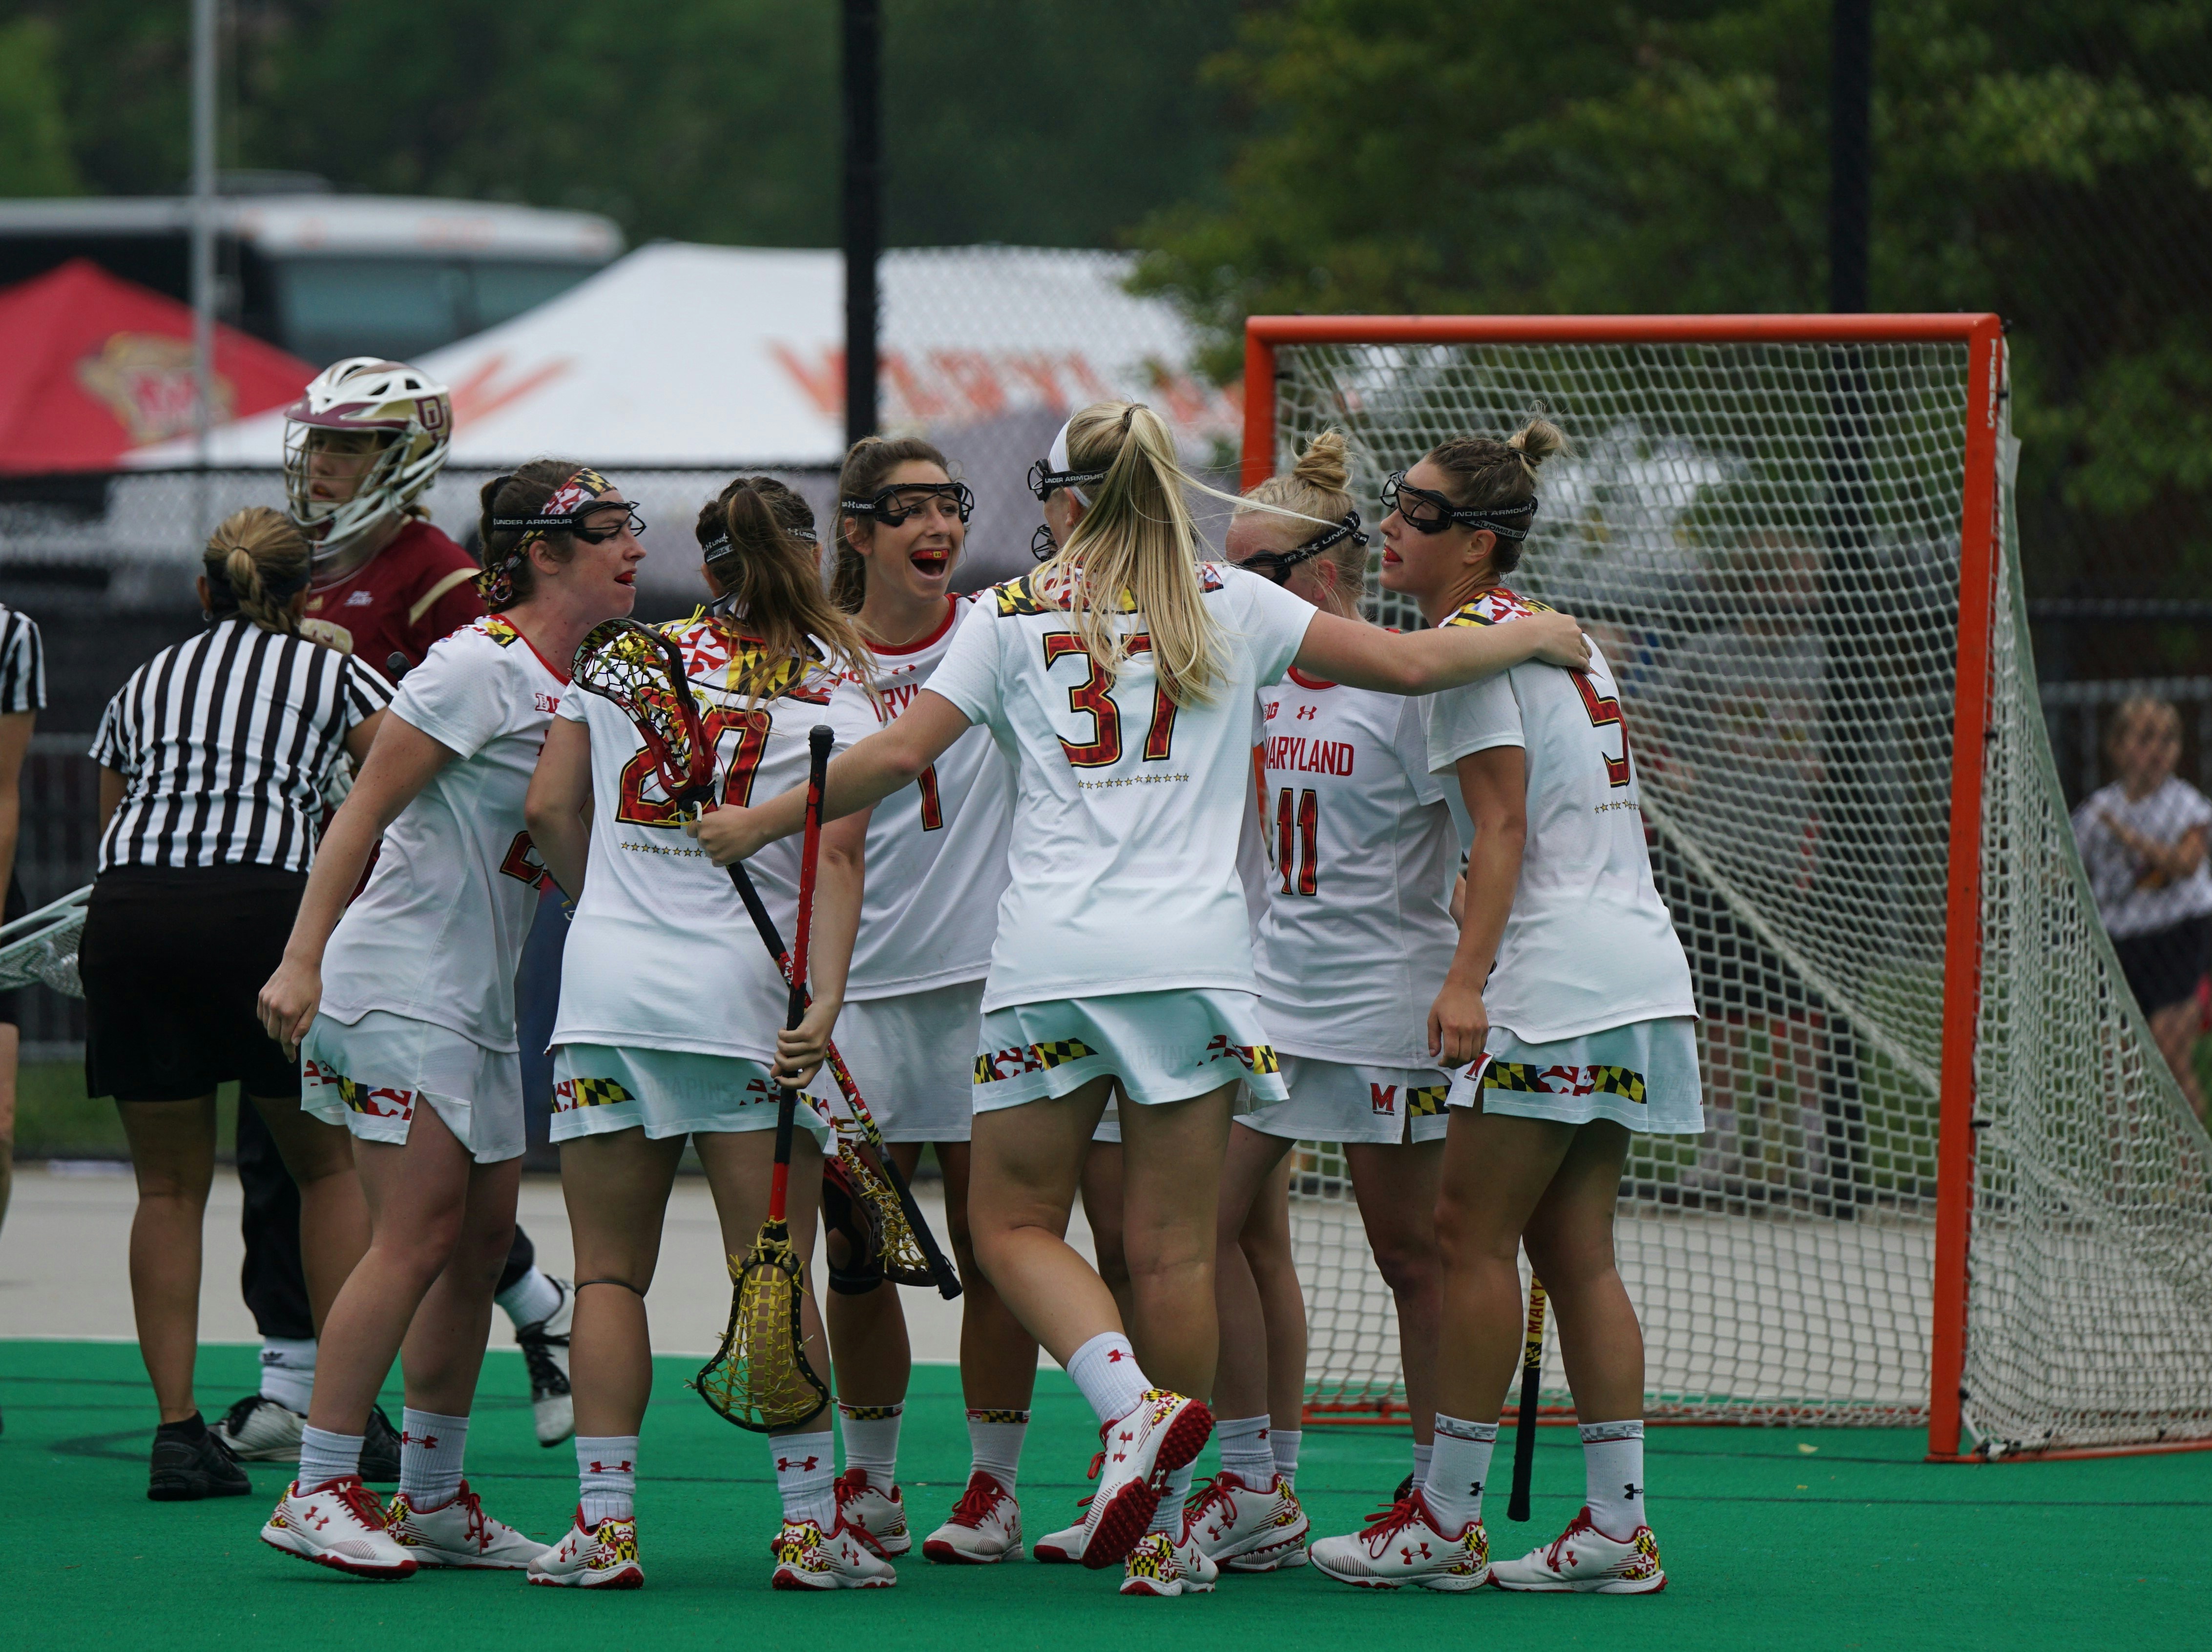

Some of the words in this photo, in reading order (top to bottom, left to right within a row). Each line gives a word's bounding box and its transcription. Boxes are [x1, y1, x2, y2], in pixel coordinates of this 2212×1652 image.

[1064, 473, 1104, 482] ARMOUR
[1491, 506, 1528, 516] ARMOUR
[1042, 631, 1182, 768] 37
[1566, 665, 1630, 788] 5
[614, 683, 772, 829] 20
[1276, 787, 1318, 897] 11
[1370, 1083, 1398, 1112] M
